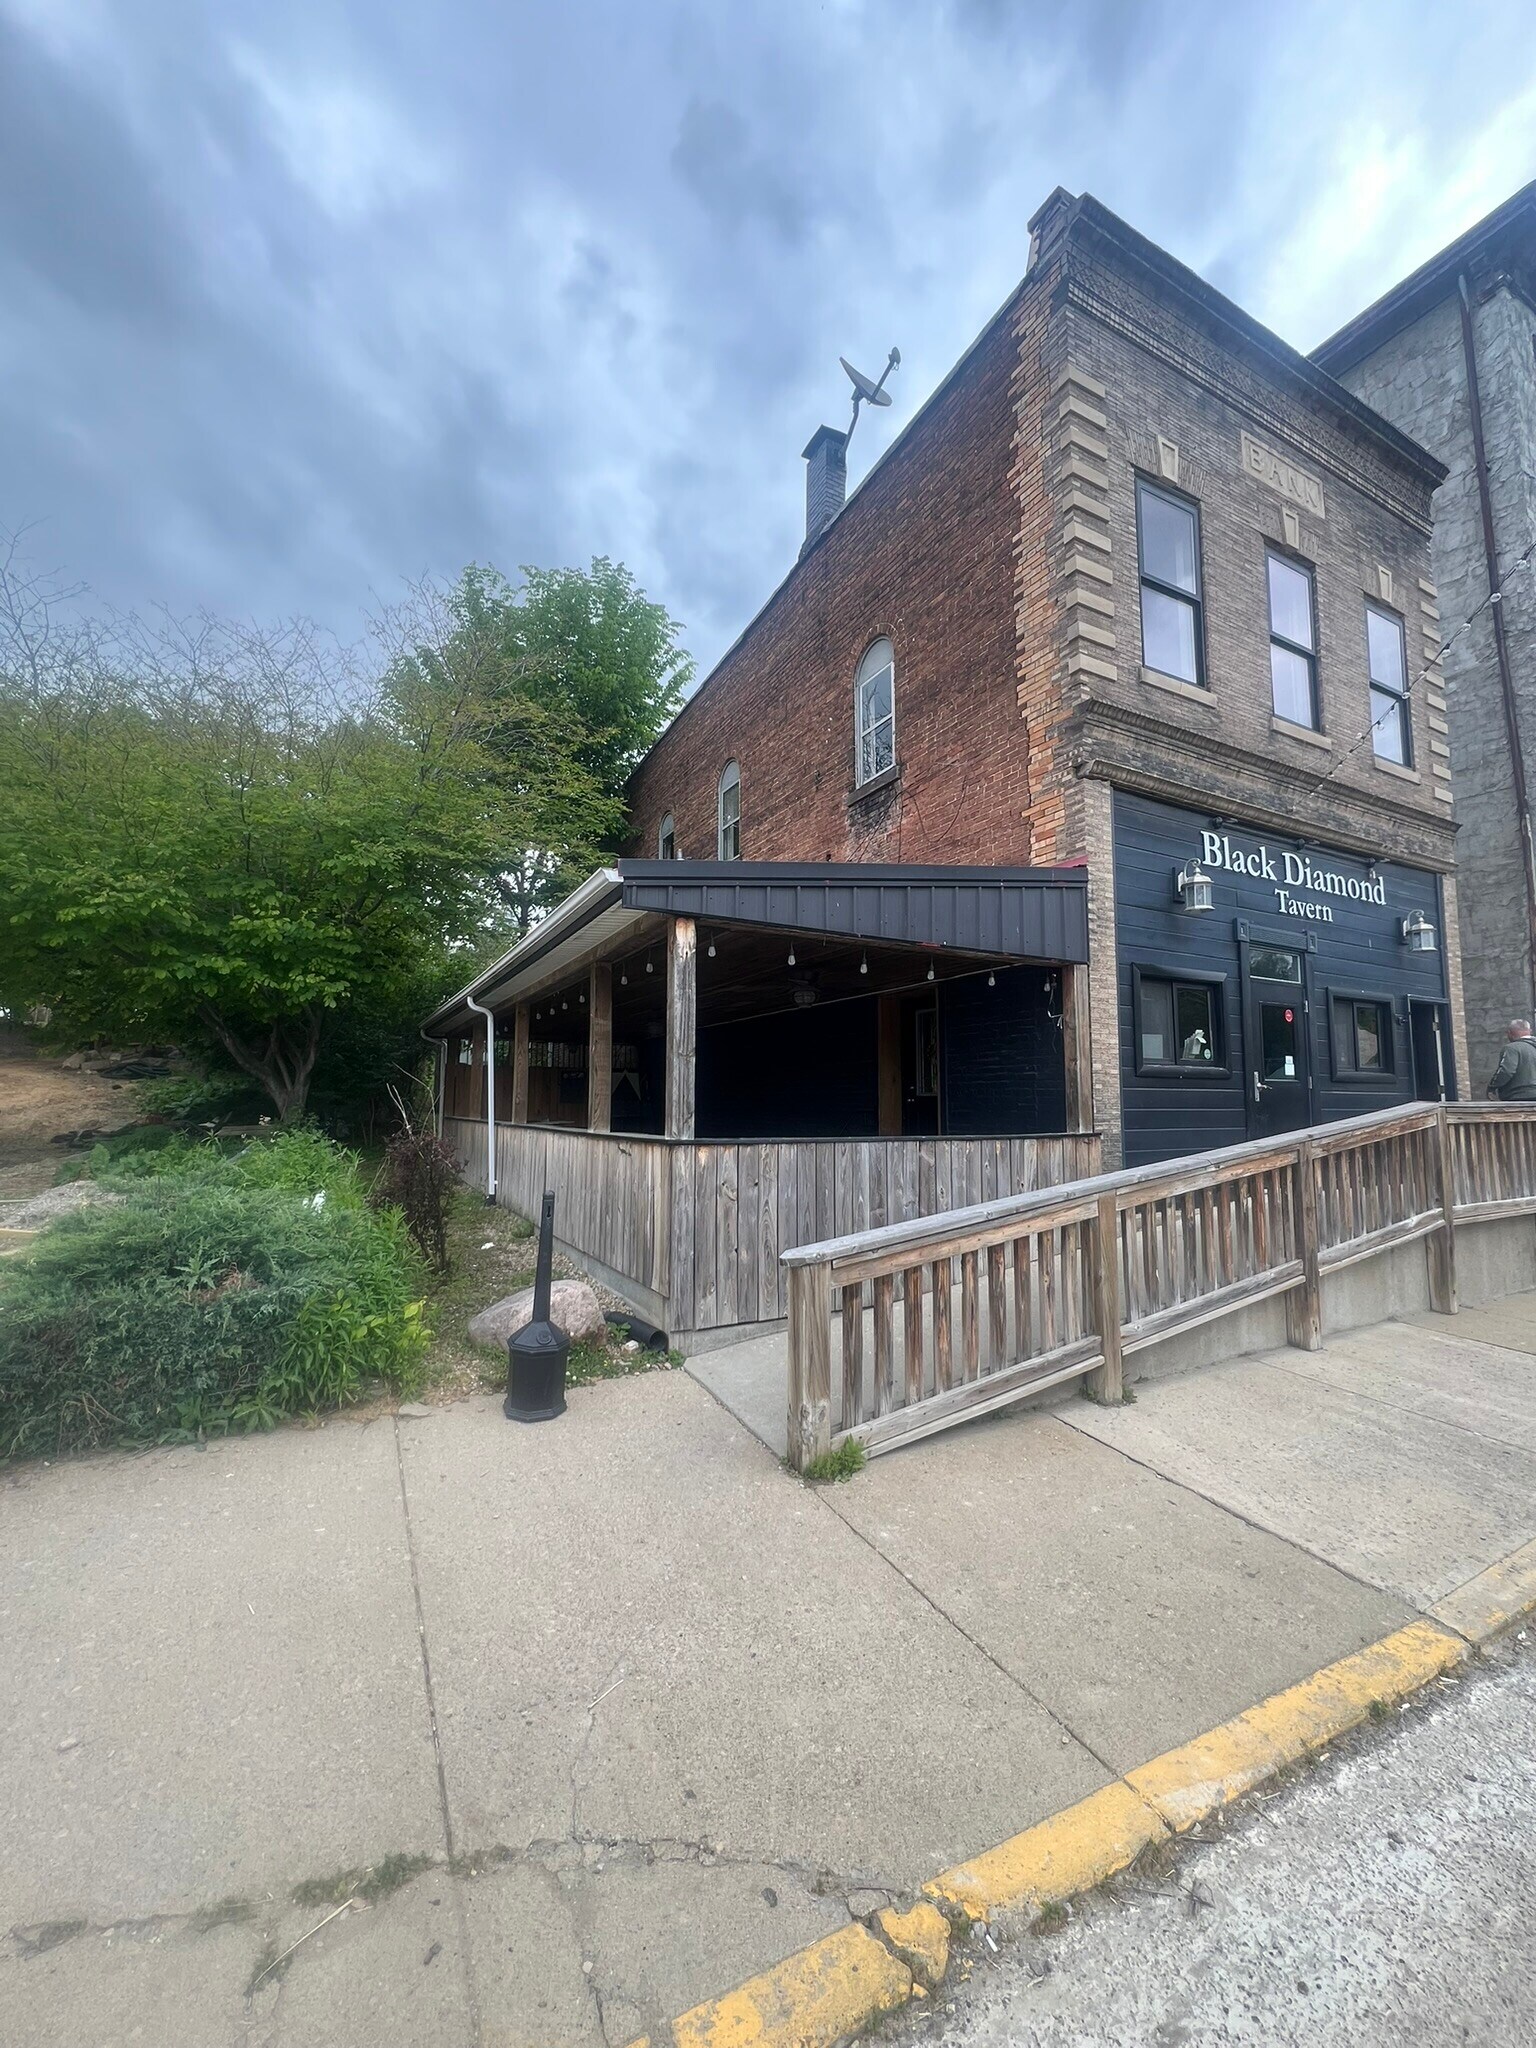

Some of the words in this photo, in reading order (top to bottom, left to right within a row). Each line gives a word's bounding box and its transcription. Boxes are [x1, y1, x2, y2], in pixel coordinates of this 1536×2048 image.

[1249, 442, 1319, 509] BANK
[1200, 830, 1277, 881] Black
[1282, 852, 1387, 905] Diamond
[1274, 888, 1333, 922] Tavern
